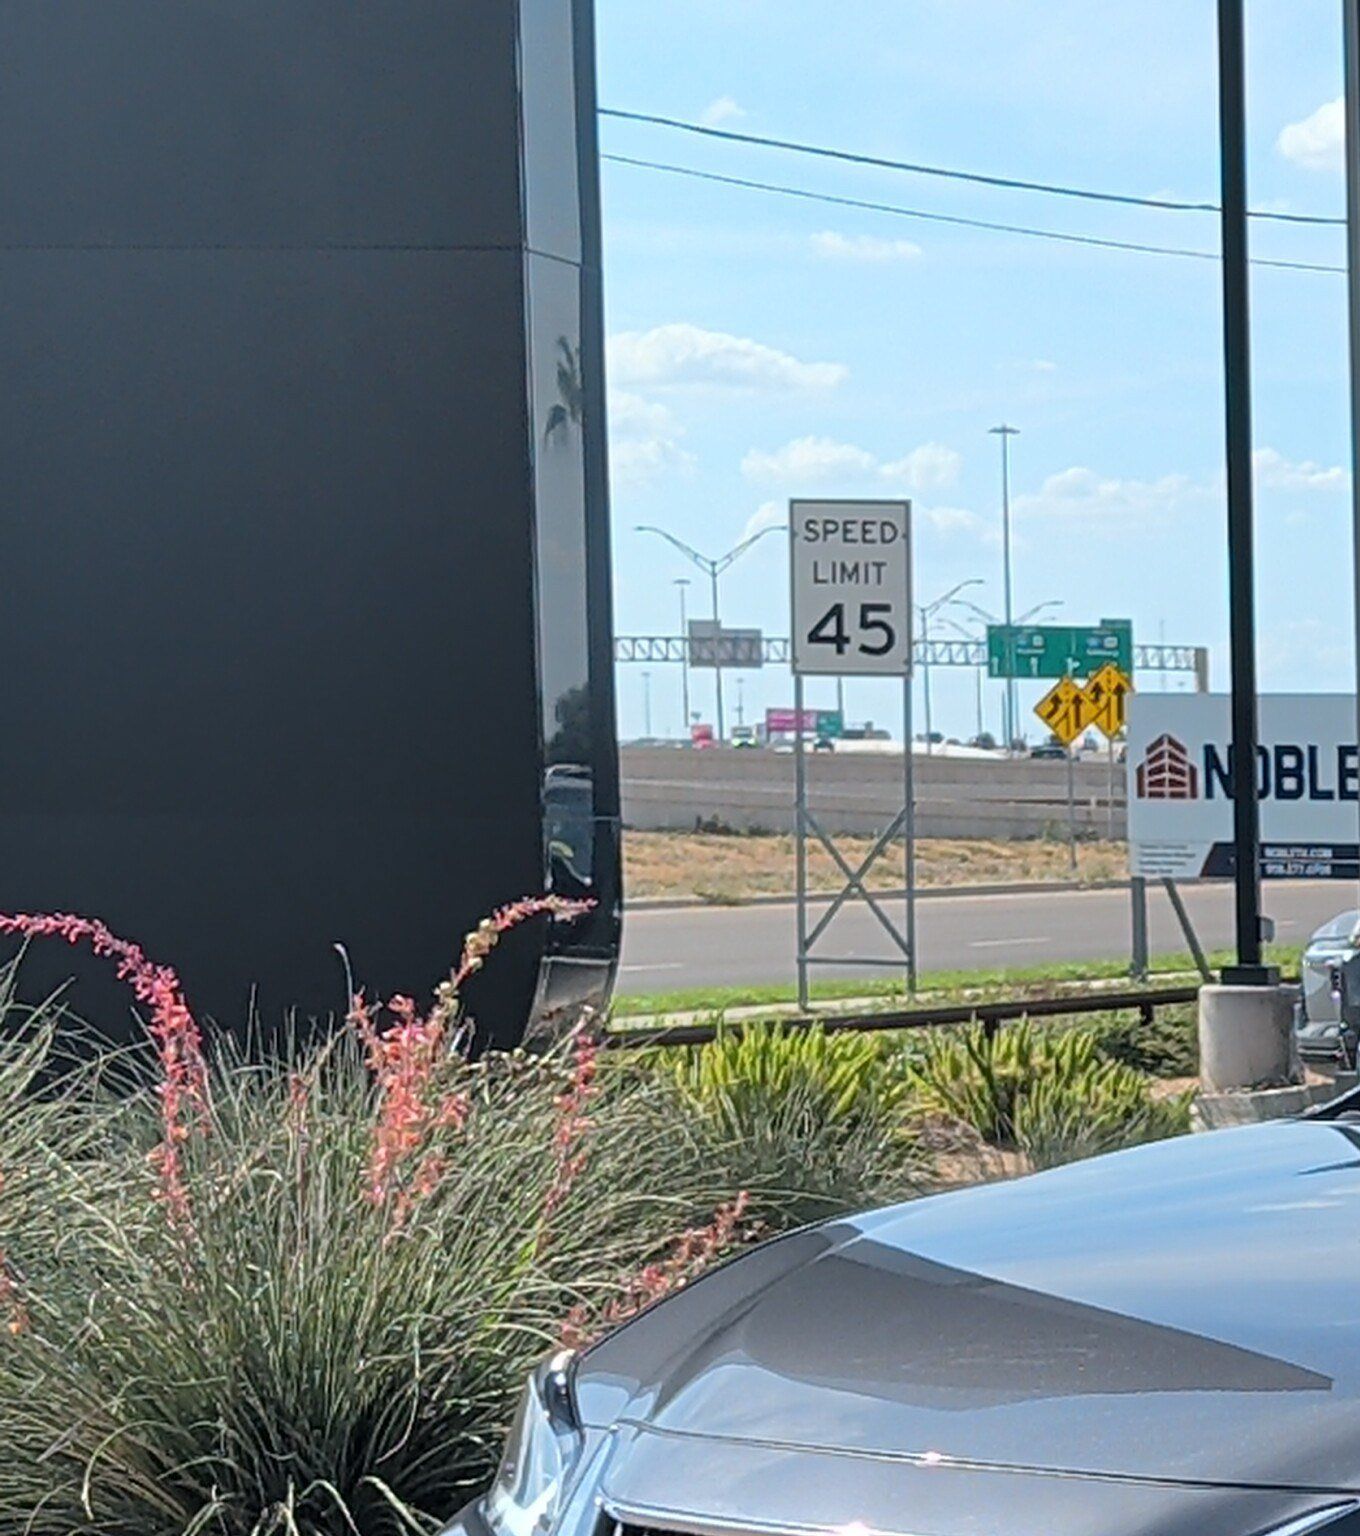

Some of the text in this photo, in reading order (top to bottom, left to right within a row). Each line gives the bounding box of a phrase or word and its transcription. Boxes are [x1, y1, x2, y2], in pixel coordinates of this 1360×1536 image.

[803, 519, 898, 544] SPEED
[813, 561, 887, 586] LIMIT
[807, 602, 896, 656] 45
